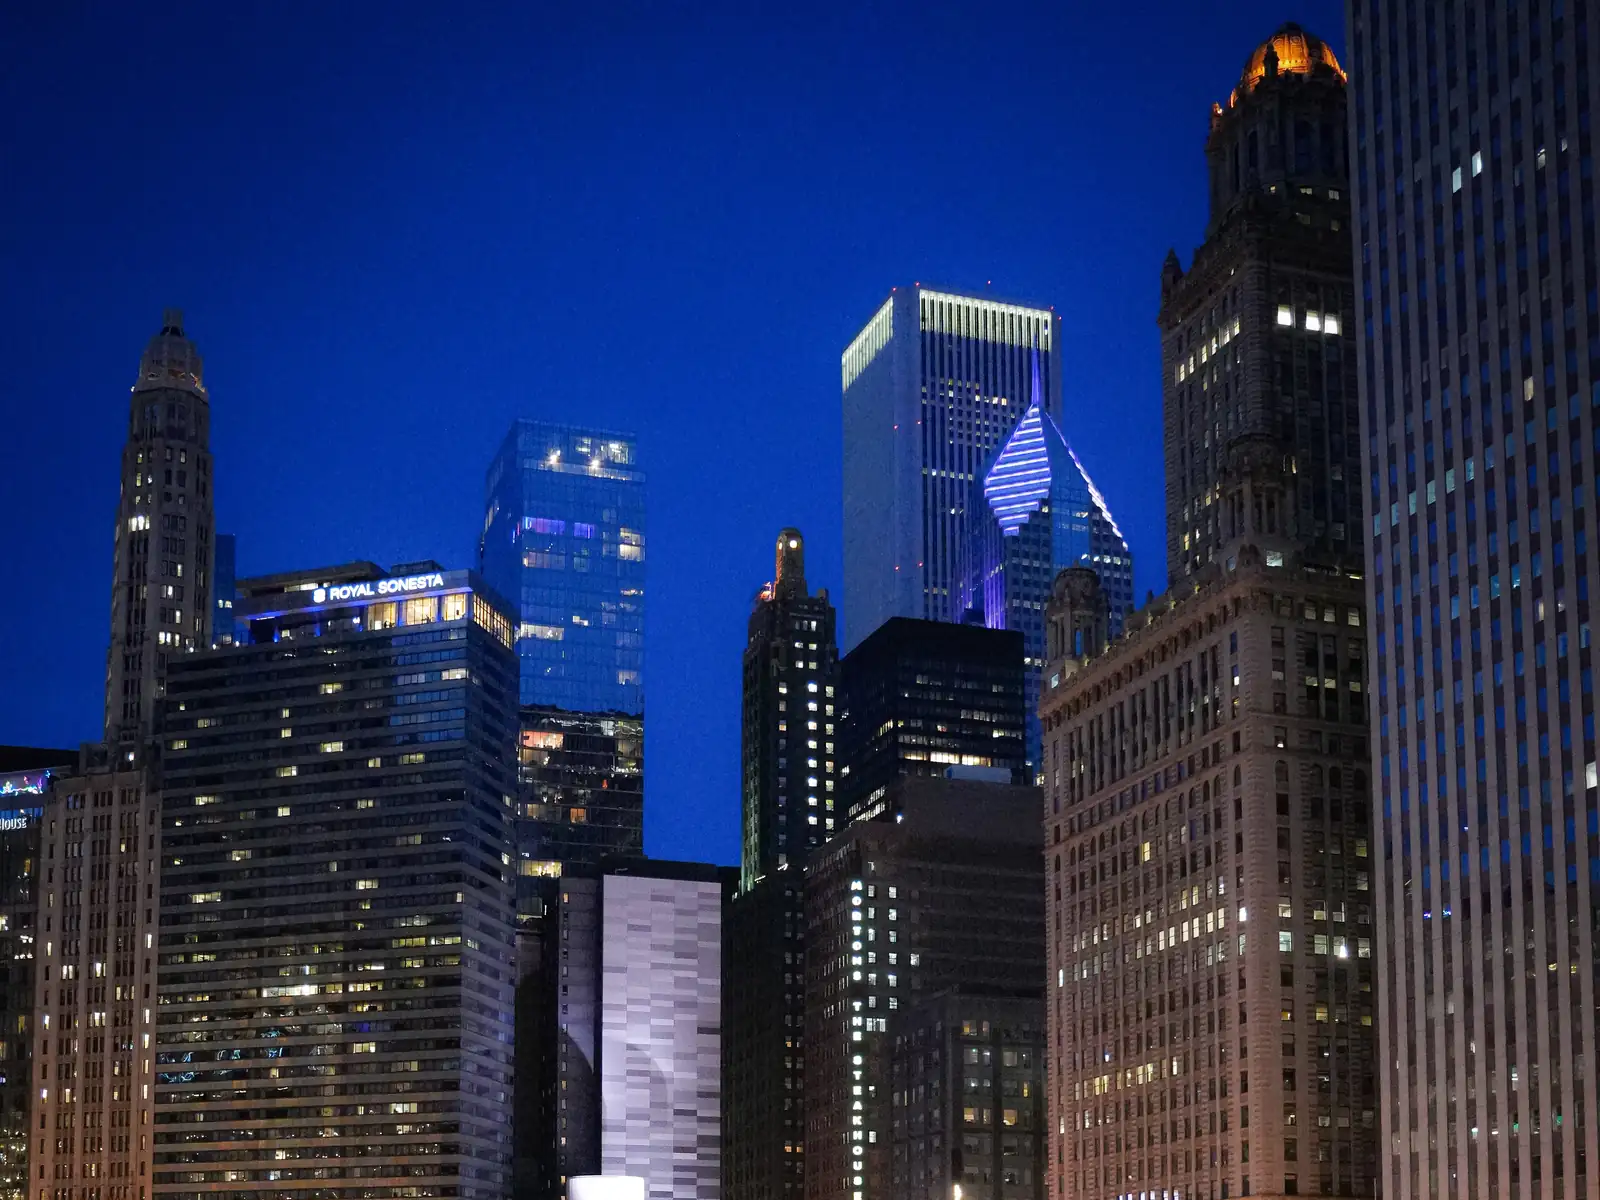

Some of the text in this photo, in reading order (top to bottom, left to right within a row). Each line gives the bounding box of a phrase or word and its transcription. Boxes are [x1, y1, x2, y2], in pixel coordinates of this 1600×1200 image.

[329, 574, 444, 601] ROYAL SONESTA
[852, 1001, 863, 1042] THE
